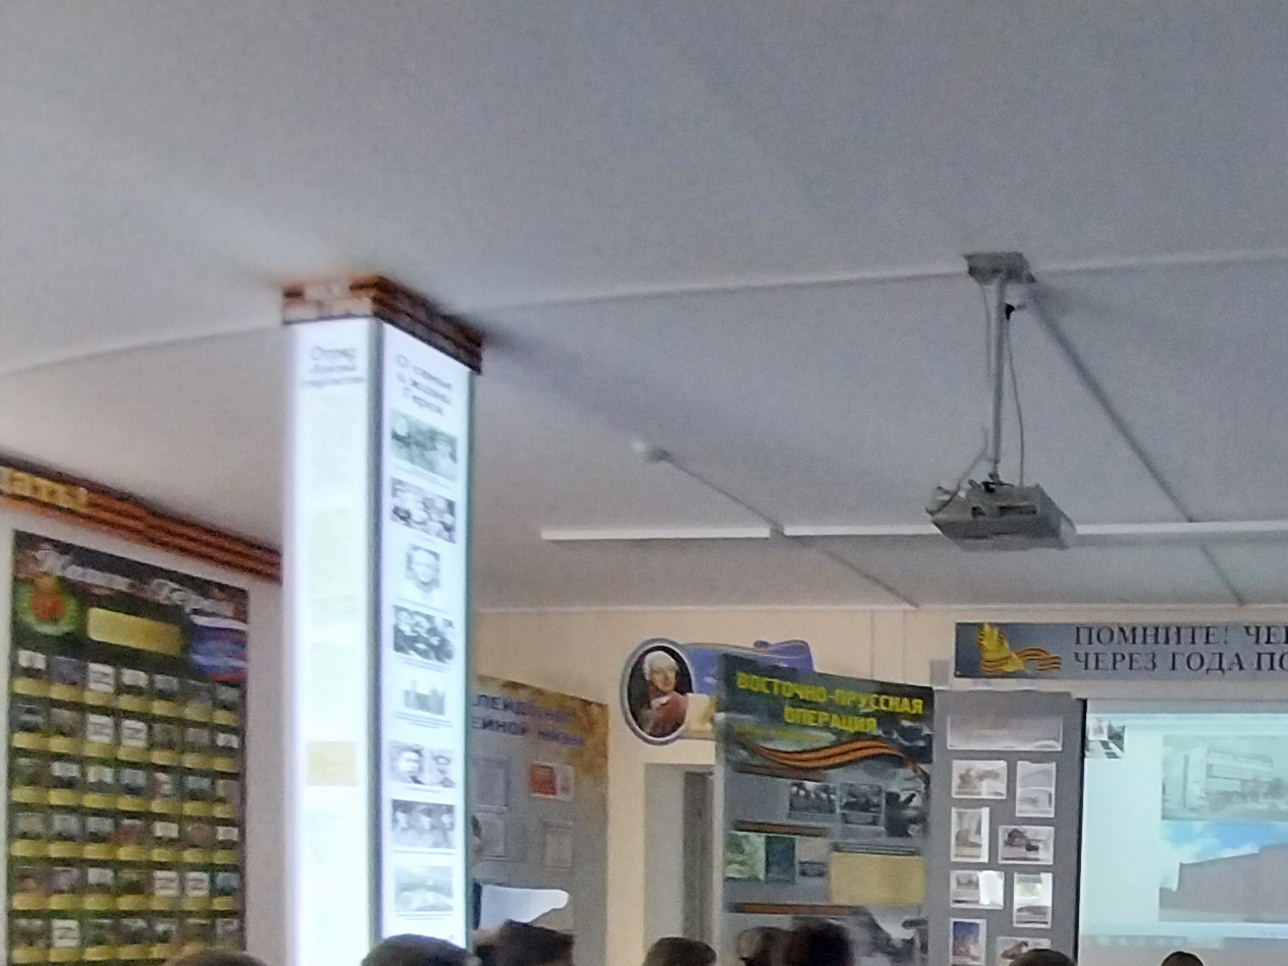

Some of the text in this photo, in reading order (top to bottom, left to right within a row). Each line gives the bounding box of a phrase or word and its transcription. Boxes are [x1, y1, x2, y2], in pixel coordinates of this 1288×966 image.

[1073, 625, 1229, 646] ПОМНИТЕ!
[1073, 651, 1157, 672] ЧЕРЕЗ
[783, 707, 878, 734] ОПЕРАЦИЯ
